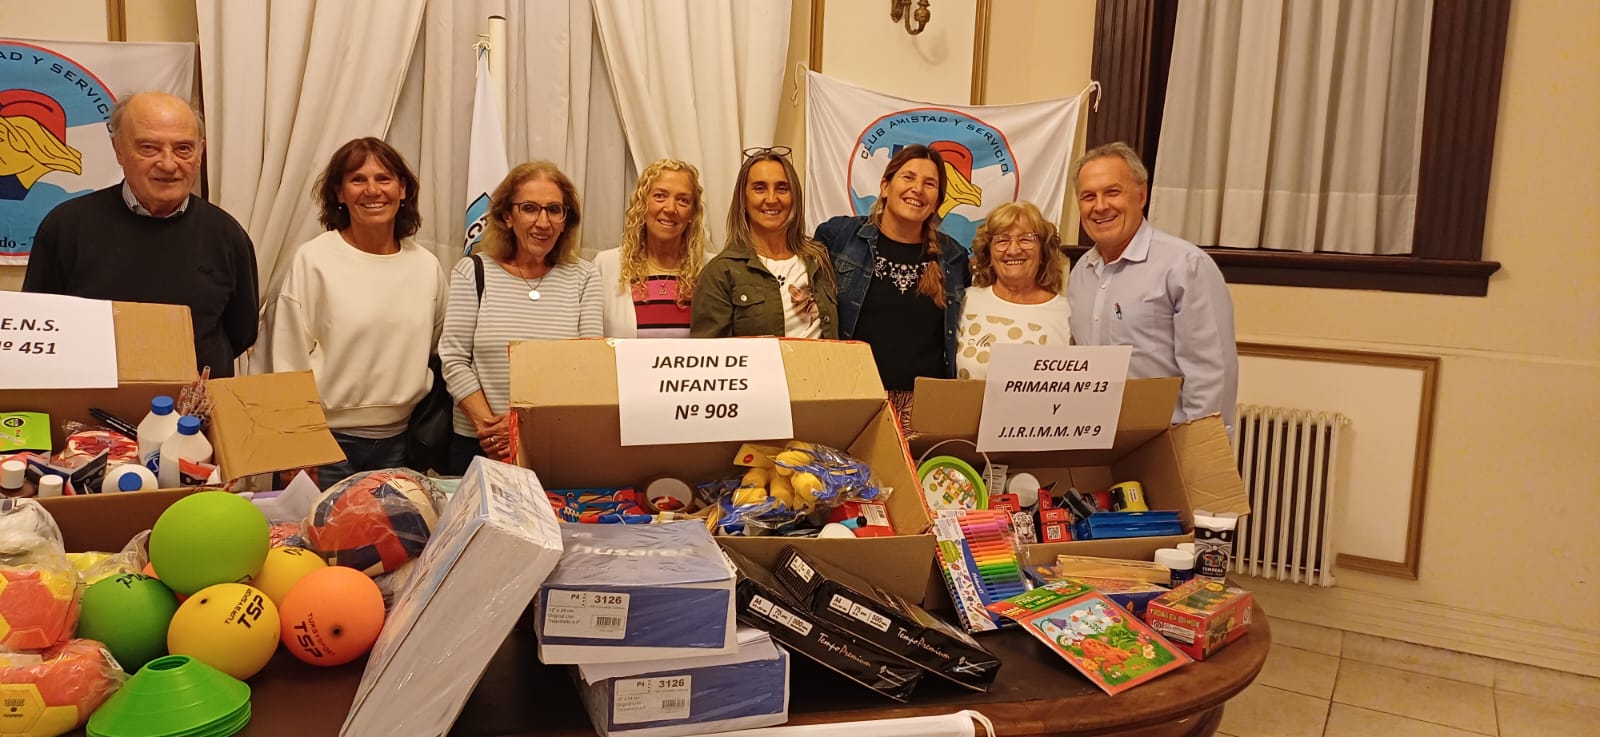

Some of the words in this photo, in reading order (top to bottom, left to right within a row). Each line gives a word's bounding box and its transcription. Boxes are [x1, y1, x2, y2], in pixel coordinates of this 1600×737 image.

[33, 55, 44, 65] Y
[861, 127, 886, 160] CLUB
[889, 115, 948, 129] AMISTAD
[966, 123, 1009, 176] SERVICIO
[0, 318, 60, 332] E.N.S.
[18, 342, 56, 354] 451
[652, 355, 719, 369] JARDIN
[724, 355, 749, 368] DE
[1033, 359, 1088, 372] ESCUELA
[659, 378, 748, 393] INFANTES
[1004, 381, 1070, 393] PRIMARIA
[1073, 381, 1091, 393] Nº
[1092, 381, 1108, 393] 13
[675, 404, 700, 420] Nº
[704, 403, 739, 419] 908
[1052, 403, 1061, 415] Y
[998, 426, 1070, 438] J.I.R.I.M.M.
[1073, 425, 1091, 437] Nº
[1092, 425, 1101, 436] 9
[594, 595, 622, 605] 3126
[237, 594, 265, 628] TSP
[294, 621, 323, 658] TSP
[658, 679, 685, 688] 3126
